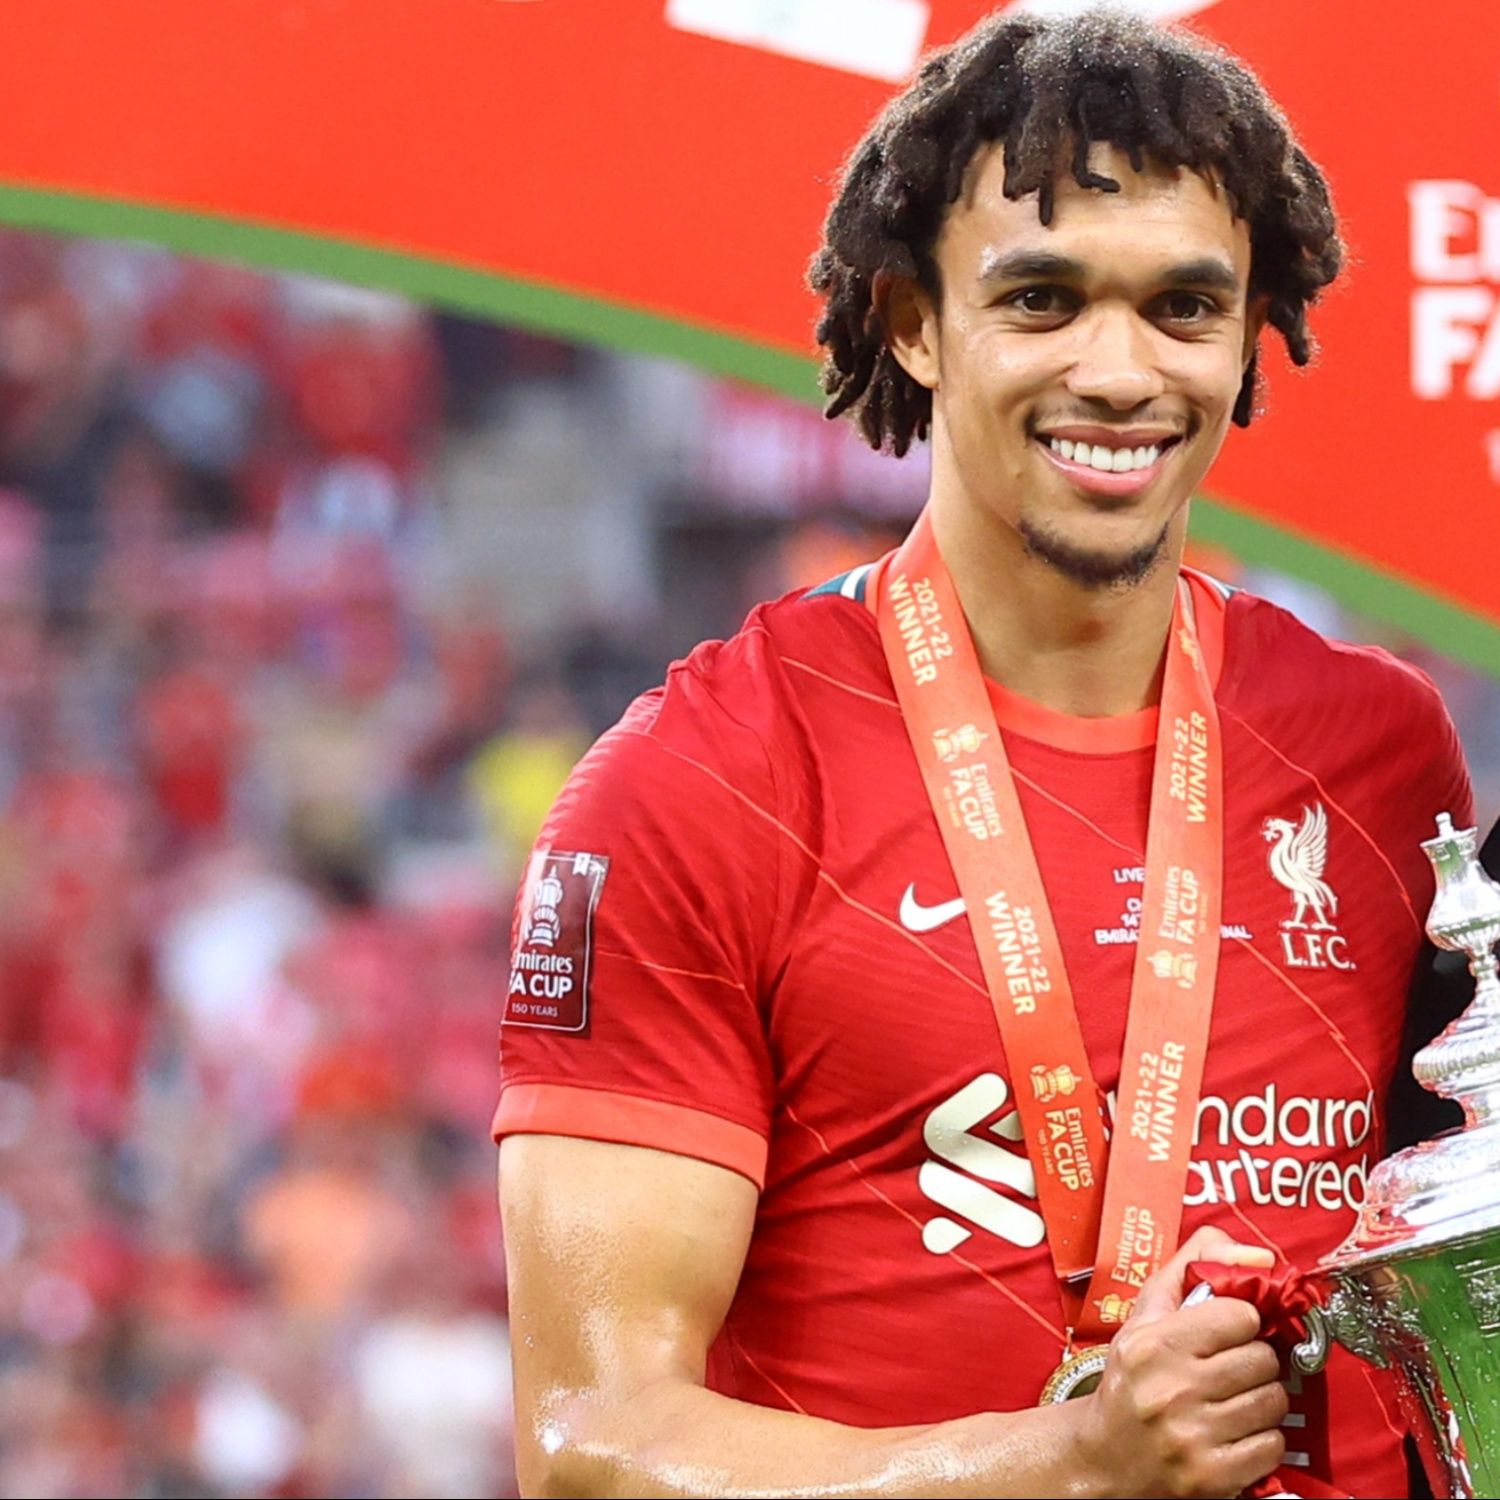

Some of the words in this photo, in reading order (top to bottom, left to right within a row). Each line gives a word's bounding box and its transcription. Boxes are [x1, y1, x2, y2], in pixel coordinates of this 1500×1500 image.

[889, 574, 937, 686] WINNER
[913, 578, 953, 661] 2021-22
[949, 767, 973, 796] FA
[1169, 717, 1189, 801] 2021-22
[1186, 711, 1207, 823] WINNER
[960, 796, 988, 840] CUP
[970, 763, 1003, 837] Emirates
[1158, 865, 1181, 939] Emirates
[1179, 869, 1200, 915] CUP
[513, 950, 573, 974] mirates
[985, 890, 1036, 1015] WINNER
[1013, 905, 1051, 993] 2021-22
[1094, 928, 1140, 944] EMIRA
[1220, 924, 1252, 939] INAL
[1176, 919, 1196, 945] FA
[1280, 932, 1356, 969] L.F.C.
[512, 1003, 528, 1014] 150
[529, 1004, 558, 1017] YEARS
[530, 975, 573, 999] CUP
[1045, 1110, 1067, 1140] FA
[1130, 1052, 1159, 1141] 2021-22
[1148, 1041, 1186, 1162] WINNER
[1190, 1083, 1374, 1148] ndard
[1053, 1142, 1080, 1190] CUP
[1065, 1107, 1094, 1187] Emirates
[1183, 1149, 1367, 1212] artered
[1111, 1205, 1138, 1282] Emirates
[1134, 1208, 1155, 1257] CUP
[1128, 1261, 1149, 1288] FA
